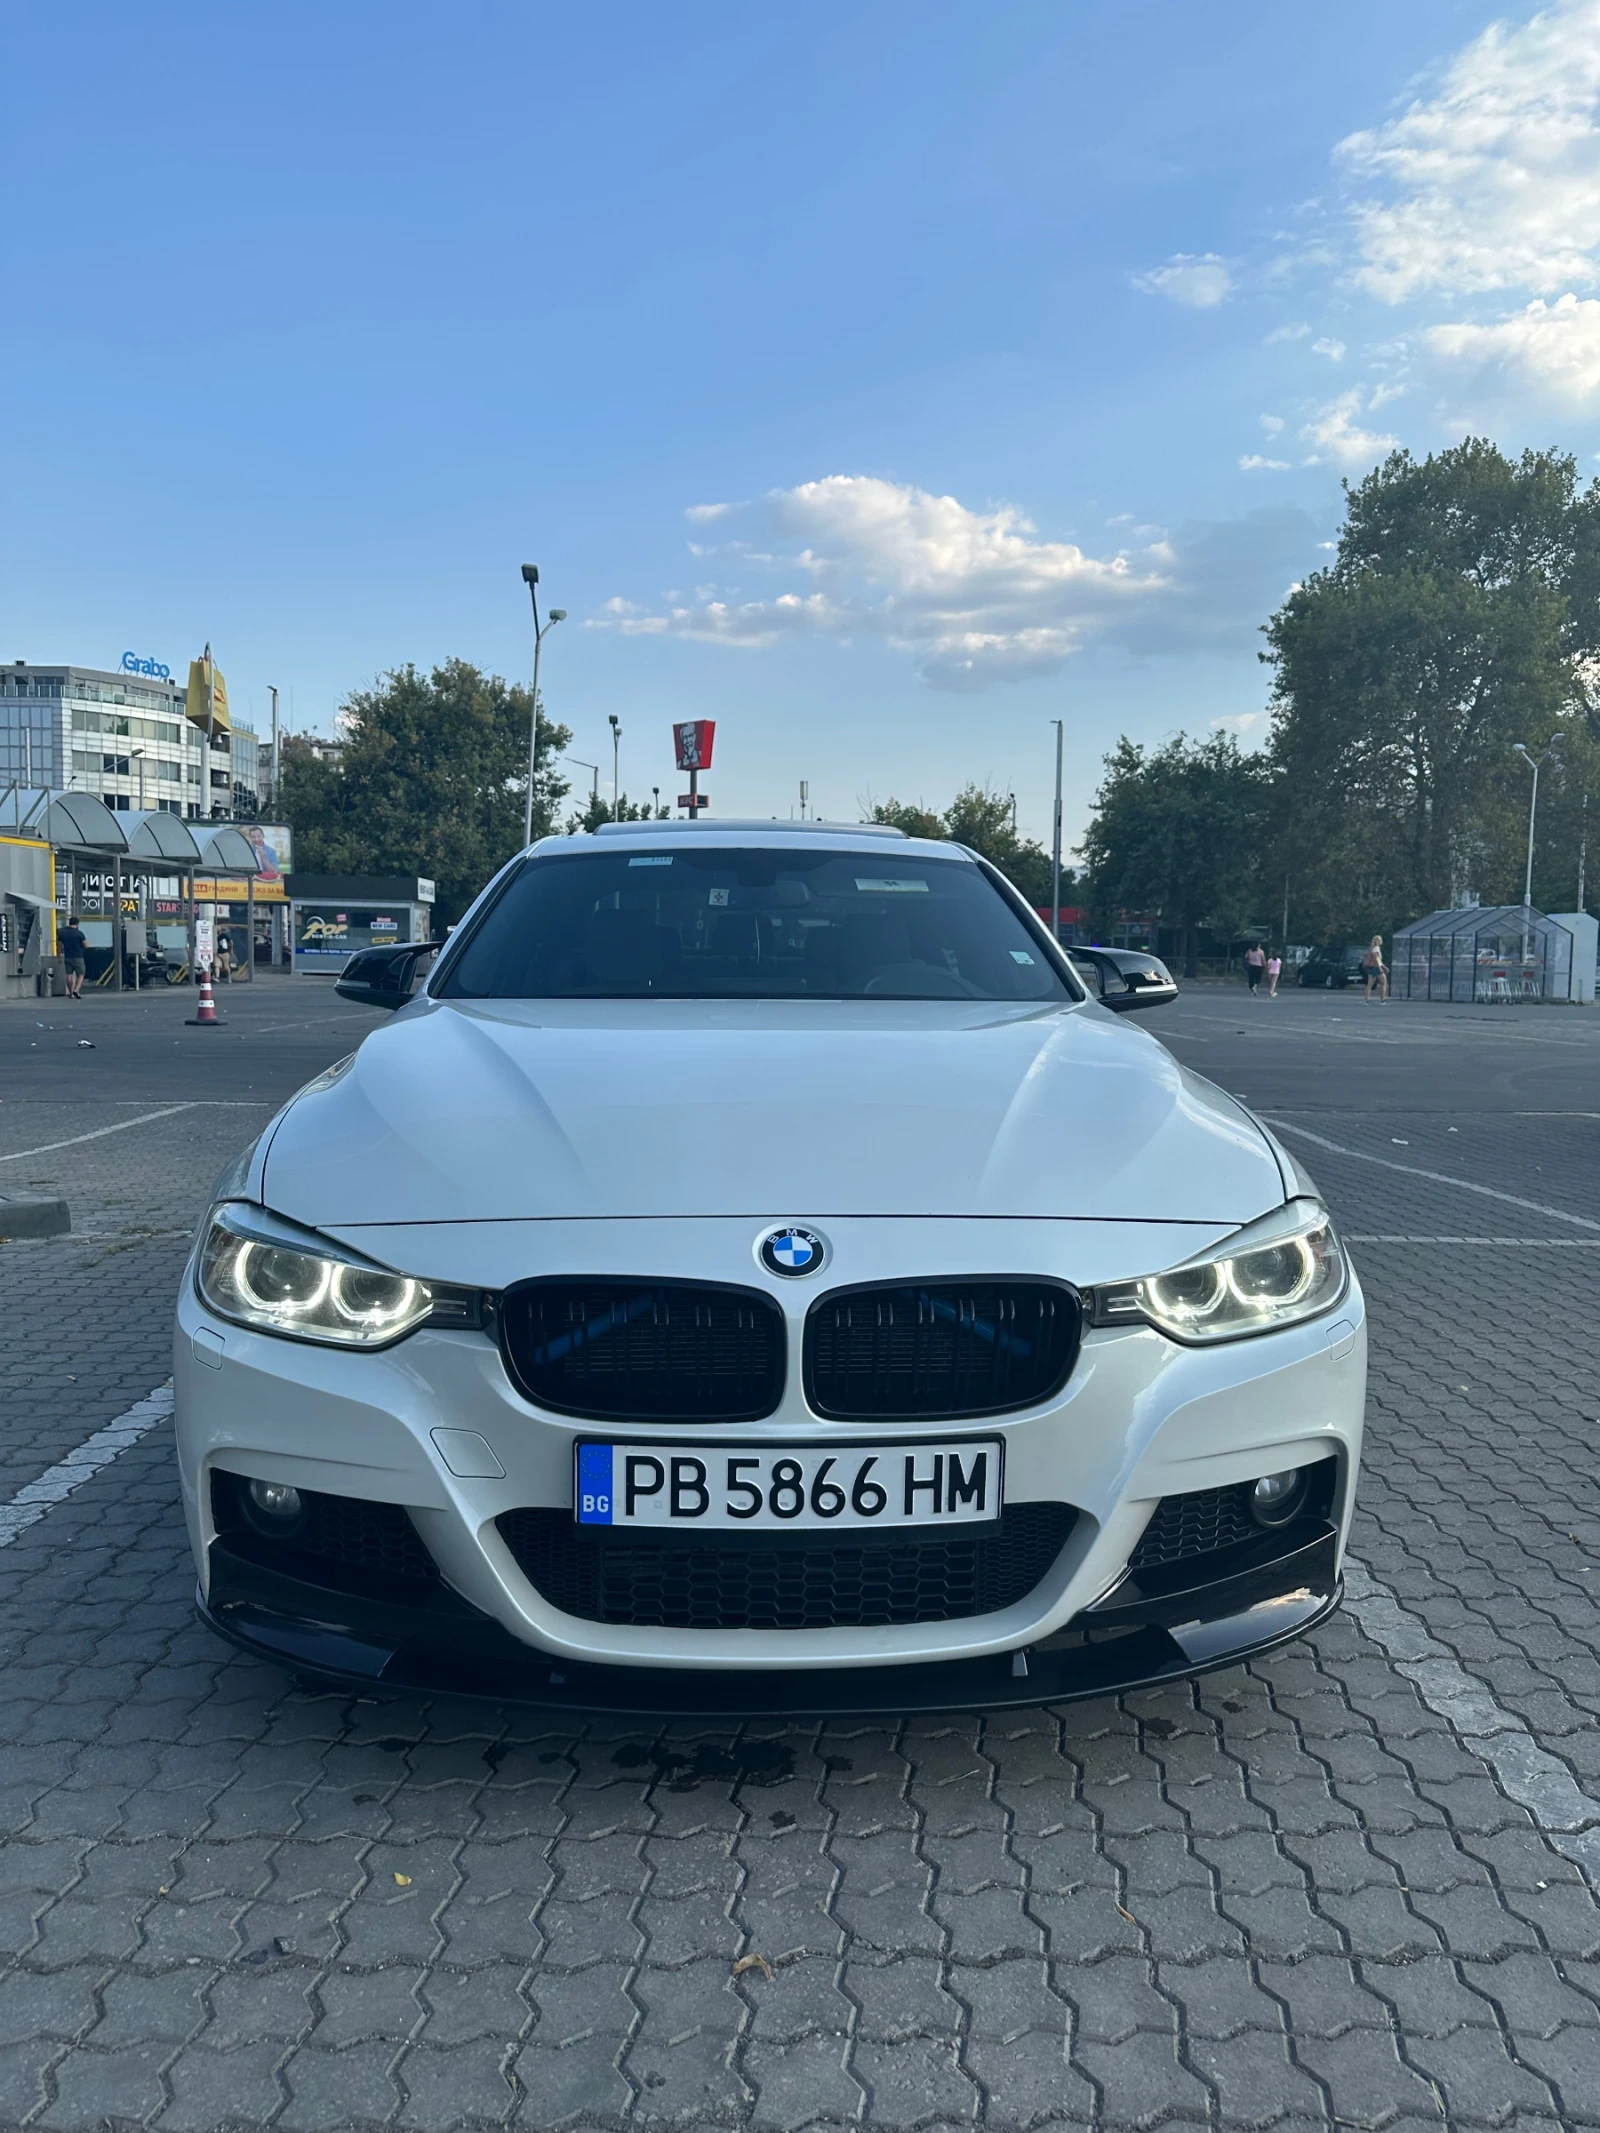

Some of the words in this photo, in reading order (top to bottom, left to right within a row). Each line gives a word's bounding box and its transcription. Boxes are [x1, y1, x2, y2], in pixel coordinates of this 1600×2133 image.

[122, 651, 170, 678] Grabo
[767, 1228, 819, 1244] BMW
[625, 1454, 710, 1517] PB
[726, 1455, 888, 1519] 5866
[903, 1451, 988, 1516] HM
[582, 1495, 609, 1513] BG
